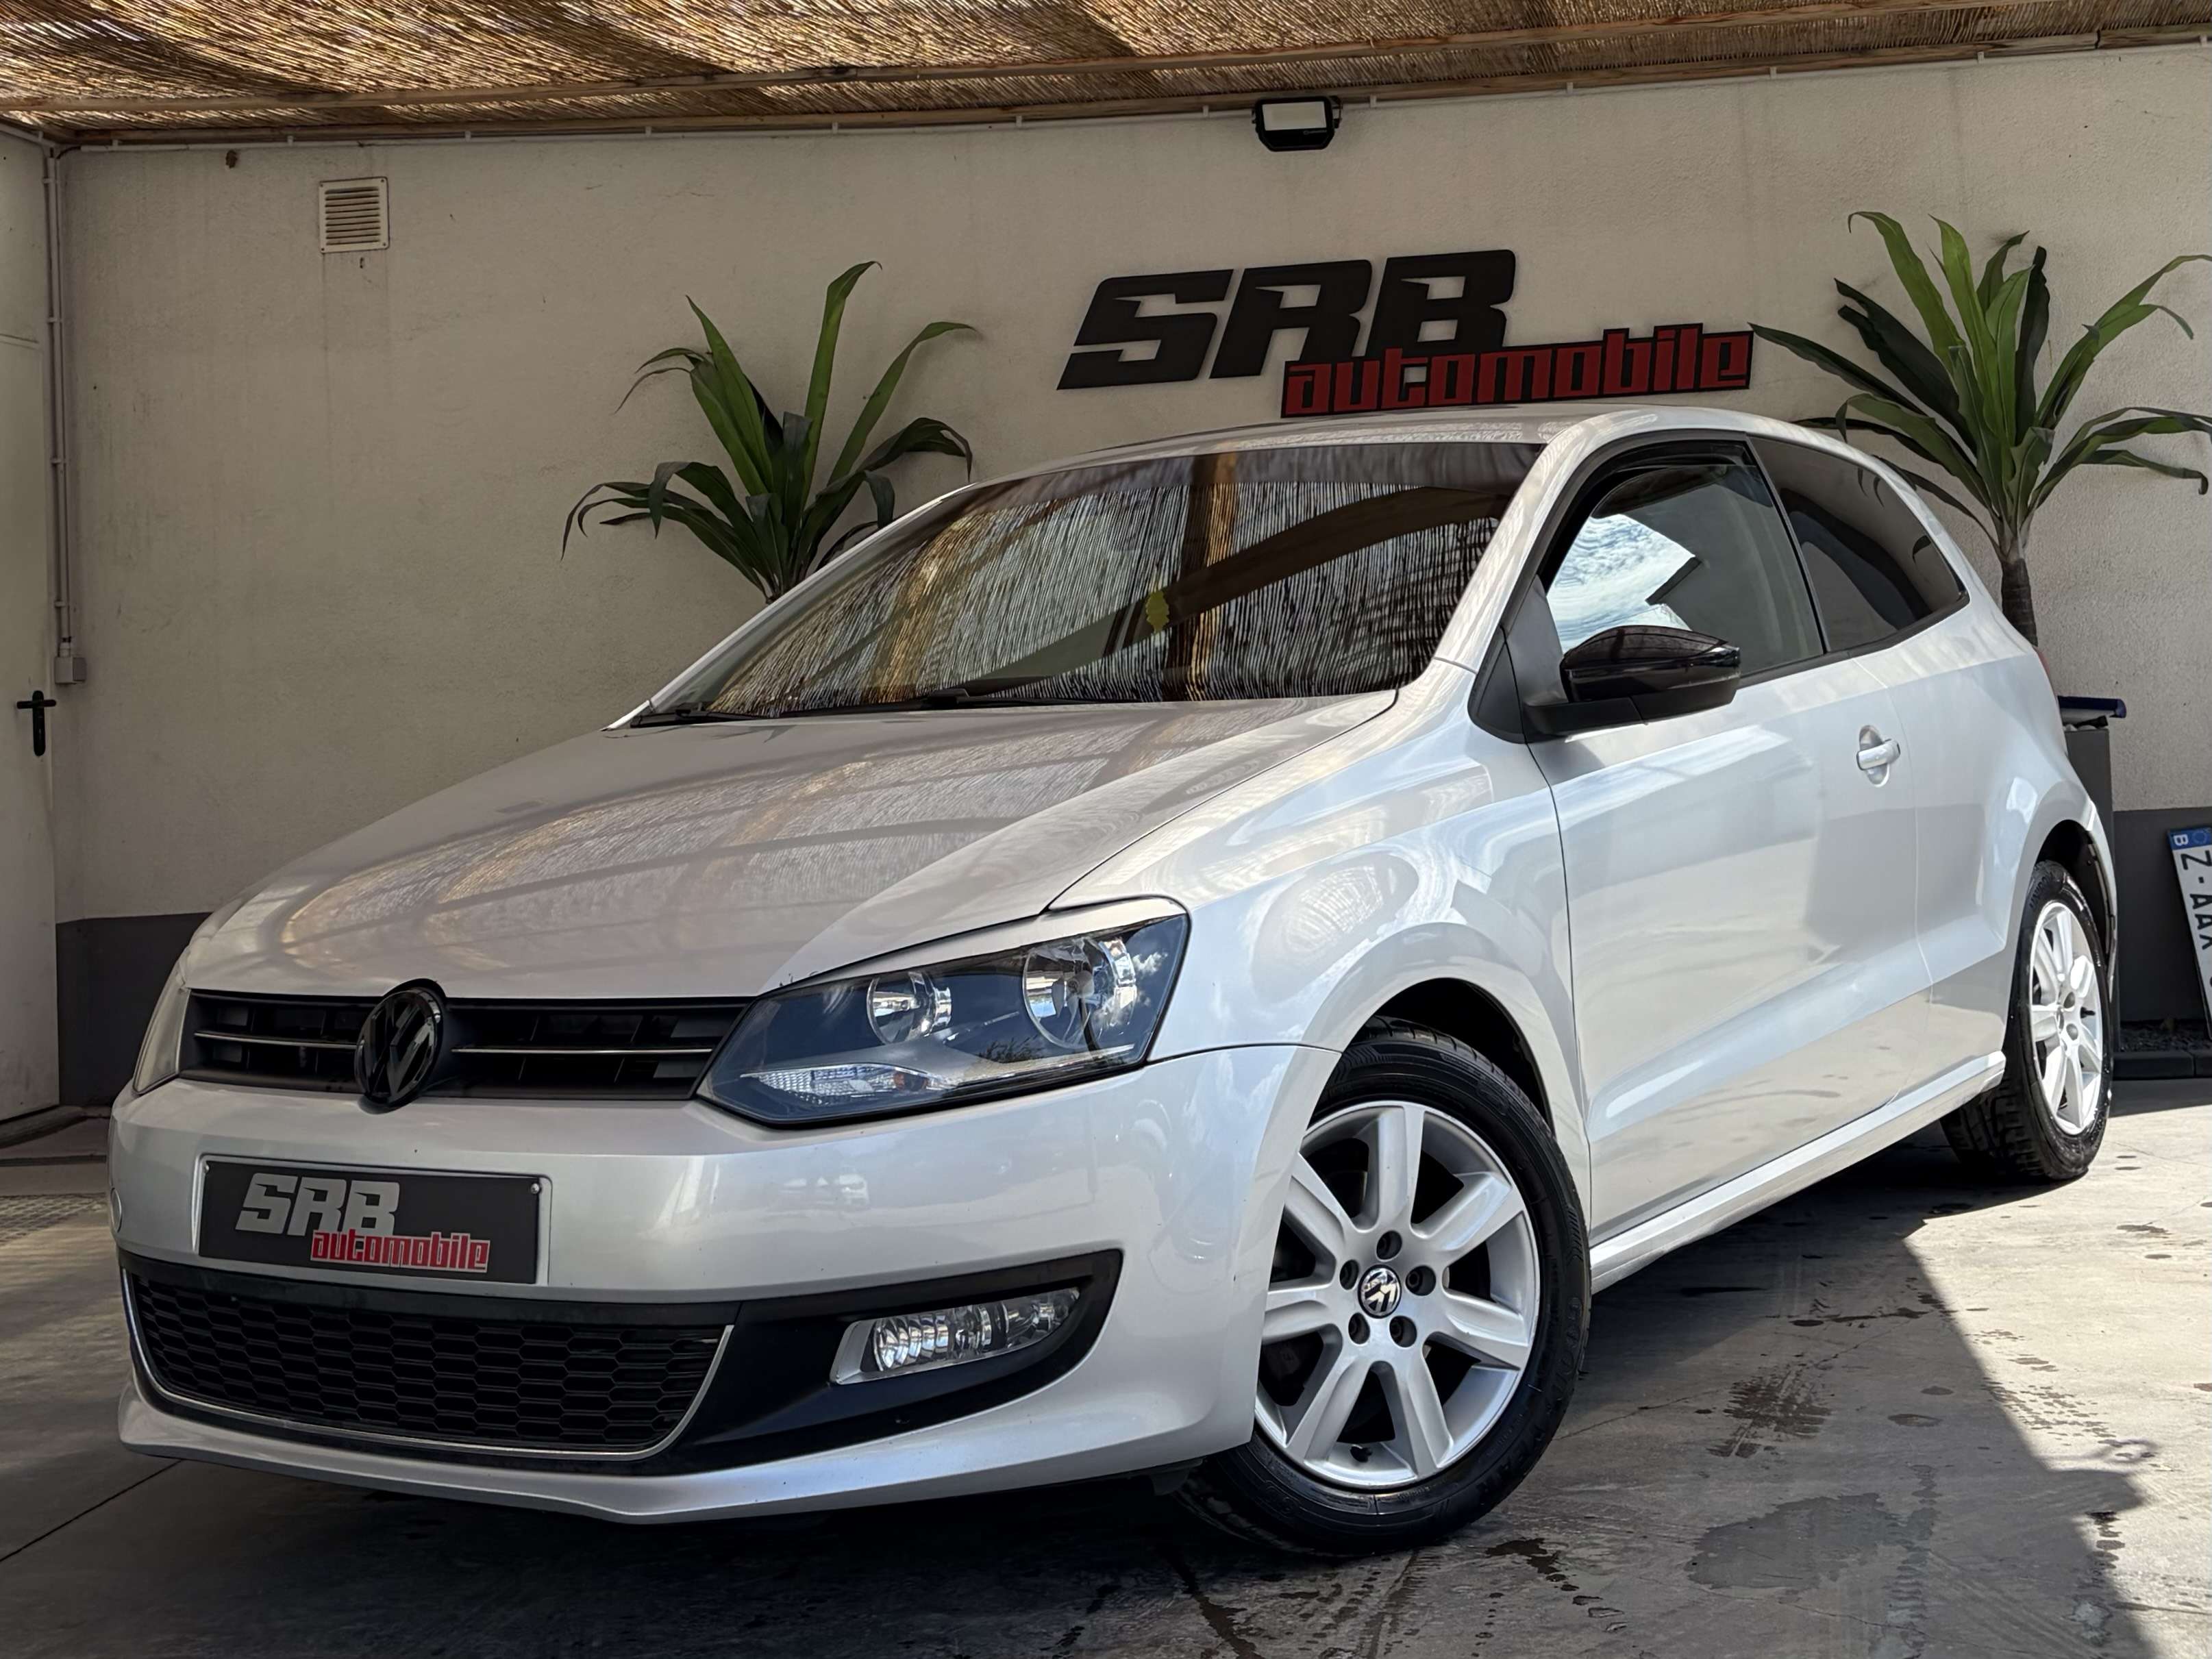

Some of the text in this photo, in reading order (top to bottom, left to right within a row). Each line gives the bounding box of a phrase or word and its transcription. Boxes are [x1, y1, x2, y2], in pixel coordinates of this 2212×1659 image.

[1057, 249, 1515, 390] SRB
[1281, 323, 1753, 418] automobile
[2174, 834, 2189, 846] B
[236, 1173, 400, 1236] SRB
[310, 1229, 490, 1273] automobile
